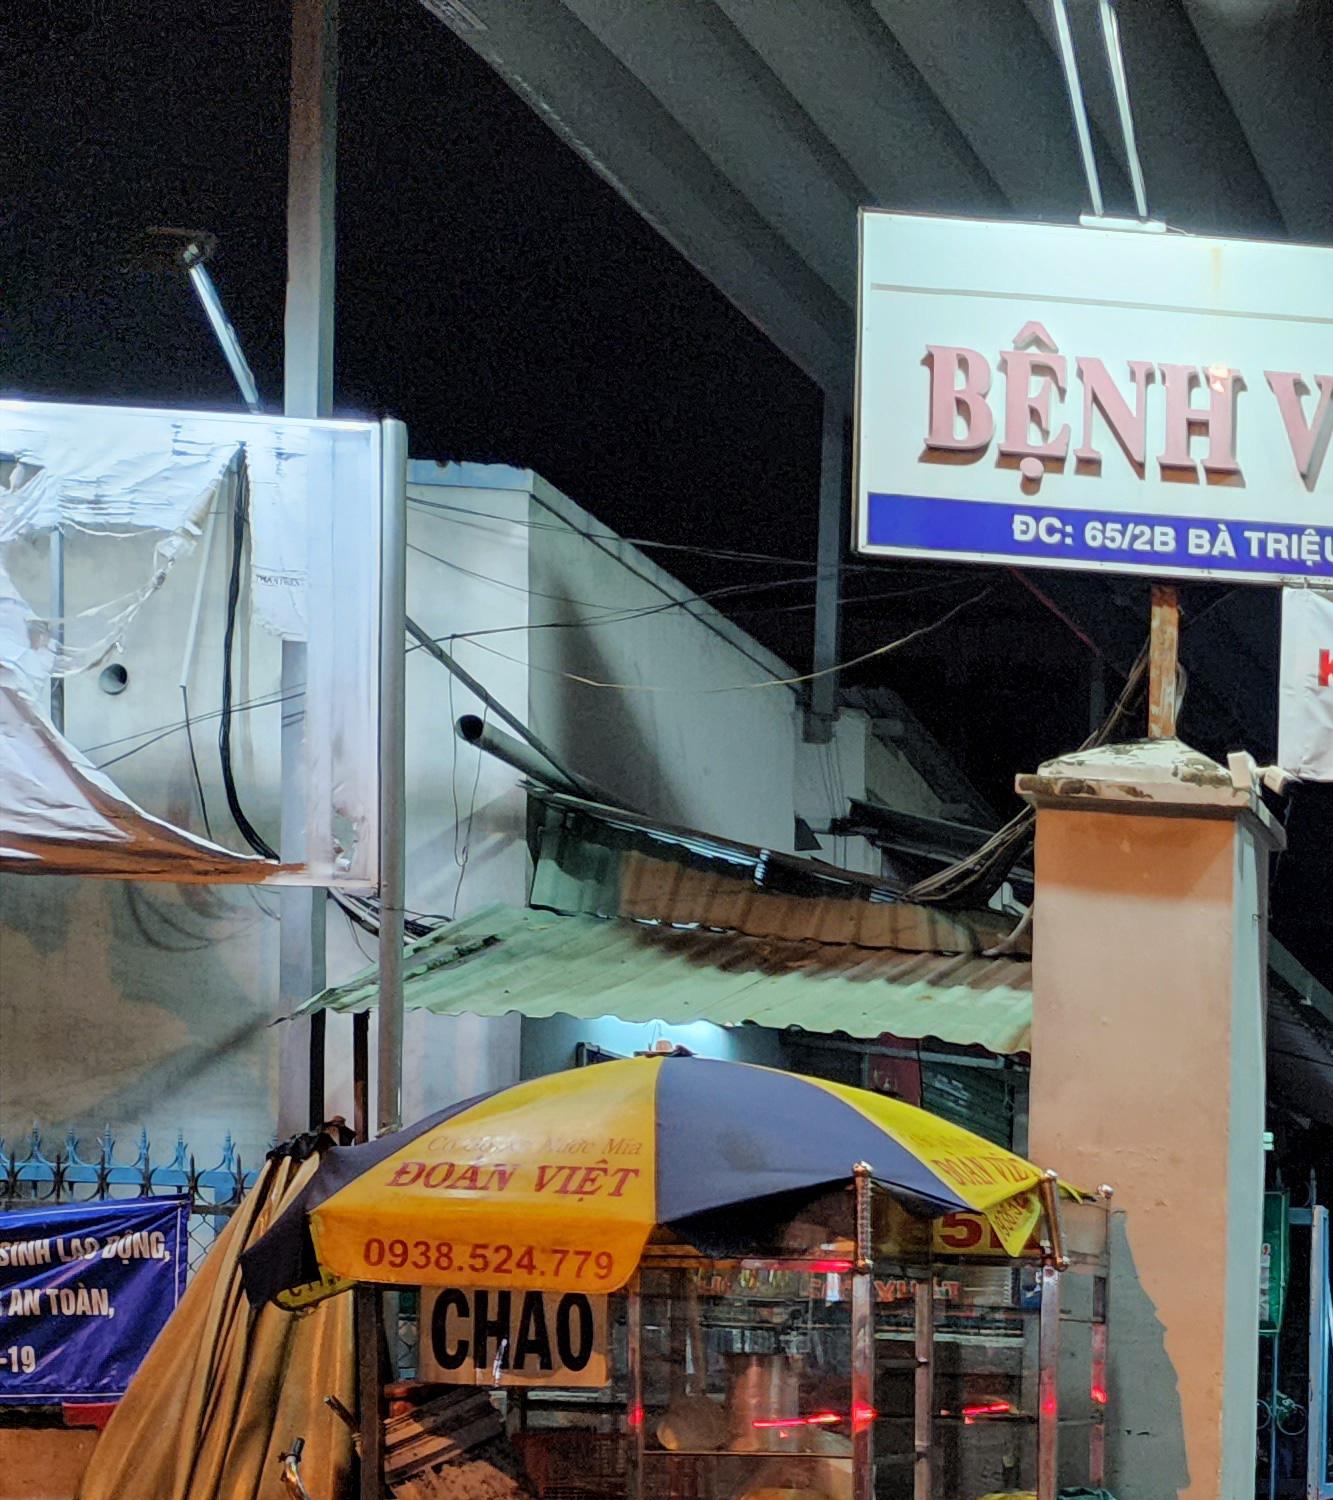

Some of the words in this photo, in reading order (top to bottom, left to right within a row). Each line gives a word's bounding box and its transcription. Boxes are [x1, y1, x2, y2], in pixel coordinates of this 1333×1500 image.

[918, 320, 1248, 494] BỆNH
[1012, 514, 1073, 545] ĐC:
[1084, 520, 1176, 555] 65/2B
[1188, 520, 1236, 560] BÀ
[601, 1138, 645, 1156] Mía
[534, 1159, 640, 1202] VIỆT
[0, 1238, 51, 1267] SINH
[56, 1237, 100, 1262] LAO
[101, 1229, 170, 1264] ĐỘNG,
[363, 1237, 614, 1280] 0938.524.779
[8, 1288, 41, 1316] AN
[46, 1283, 115, 1319] TOÀN,
